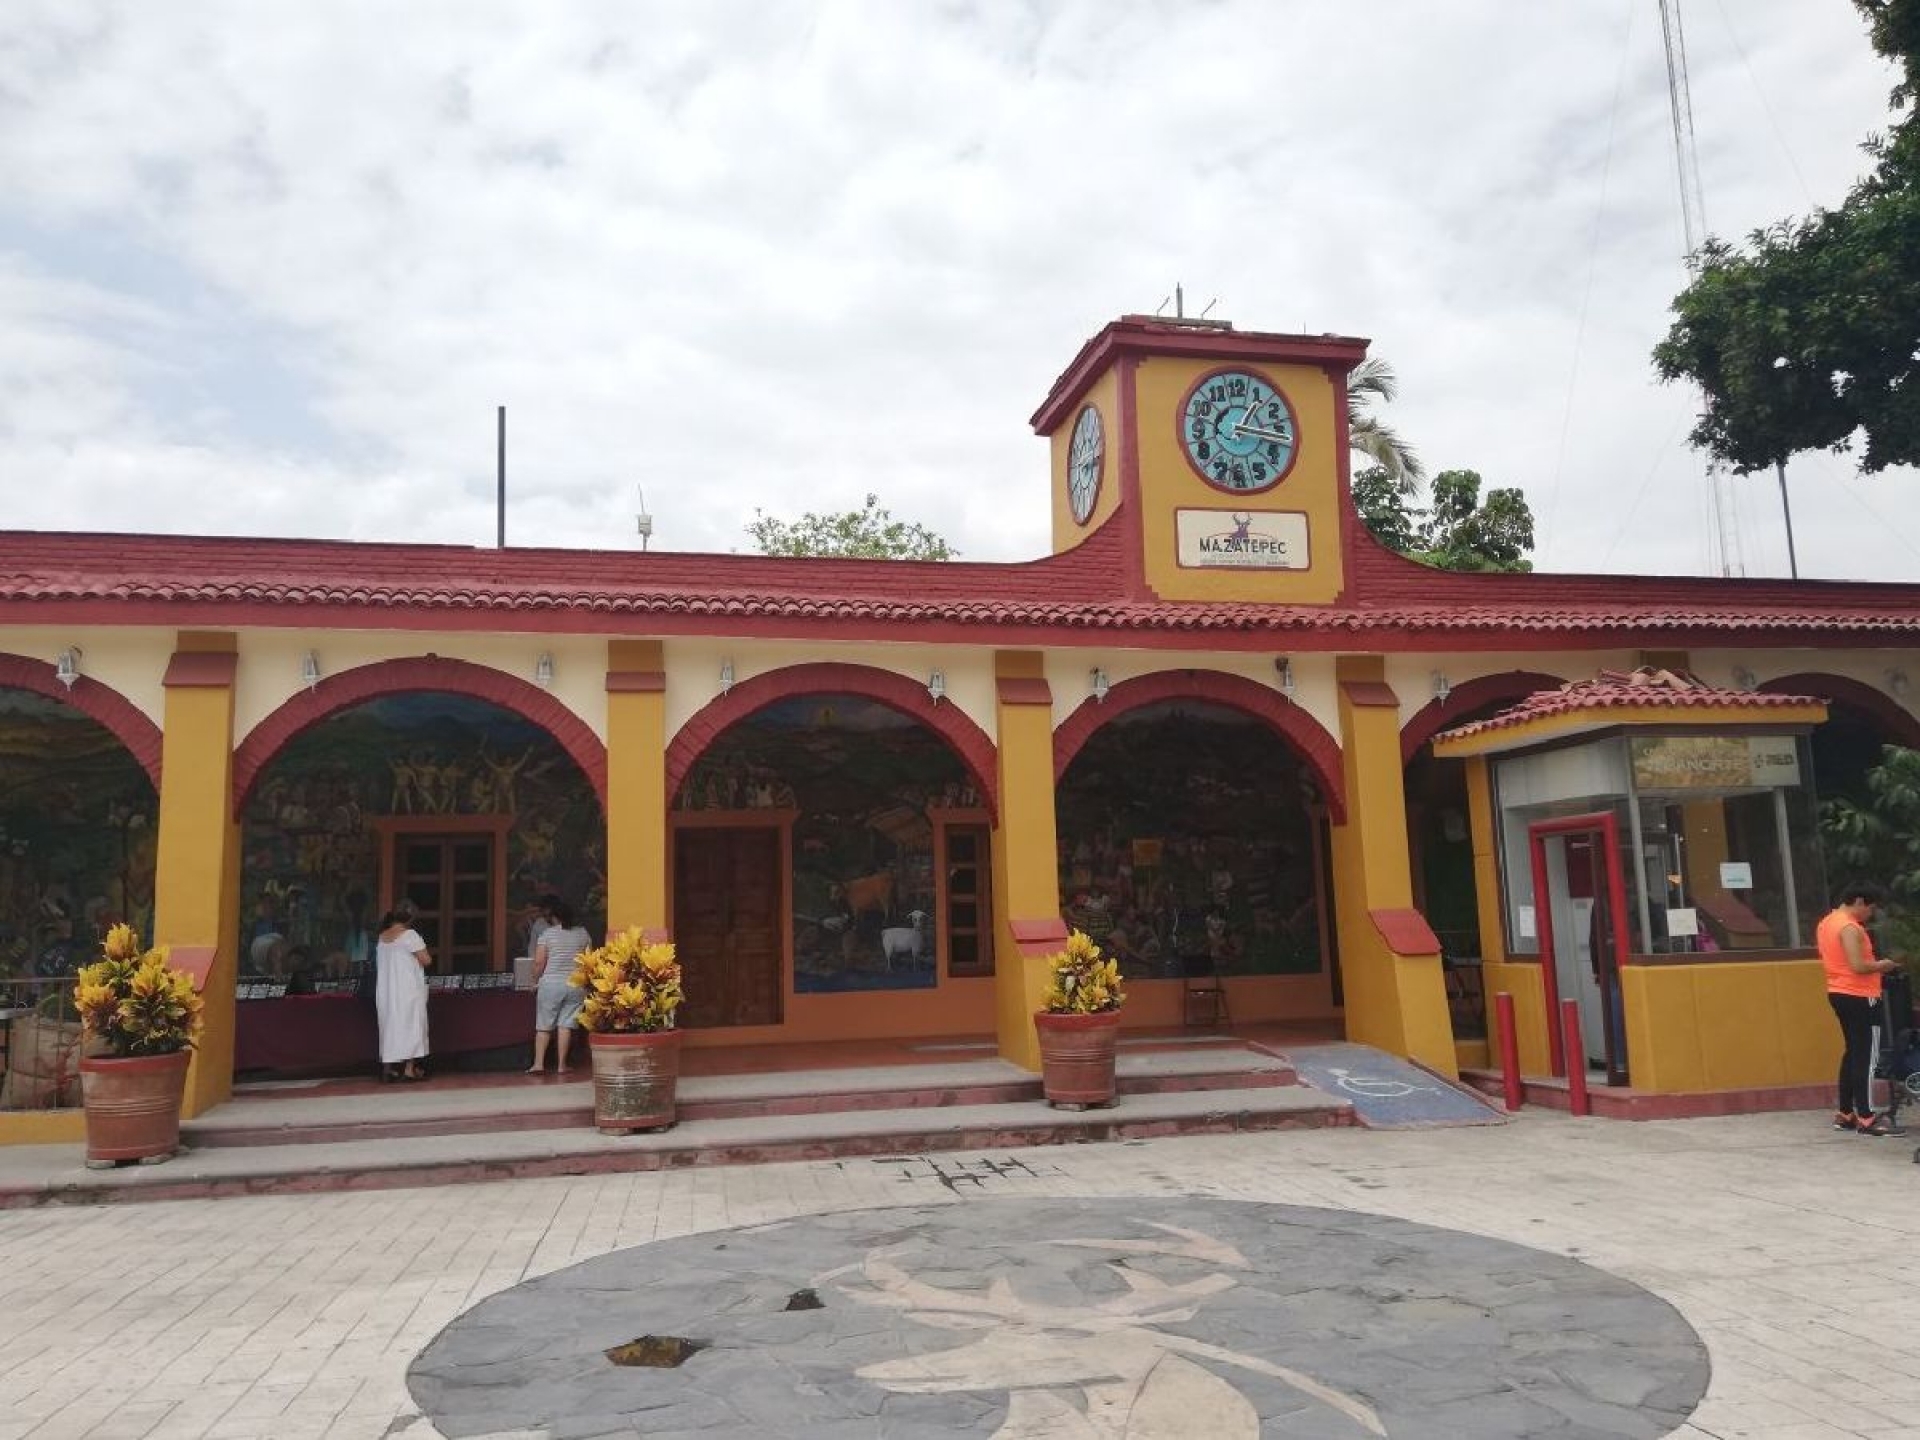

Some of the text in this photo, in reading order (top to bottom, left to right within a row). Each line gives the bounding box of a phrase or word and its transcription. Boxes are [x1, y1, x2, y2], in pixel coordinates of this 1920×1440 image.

[1209, 385, 1226, 402] 11
[1228, 379, 1246, 397] 12
[1268, 402, 1280, 419] 2
[1197, 441, 1210, 460] 8
[1213, 461, 1228, 481] 7
[1252, 461, 1266, 481] 5
[1199, 537, 1287, 554] MAZATEPEC
